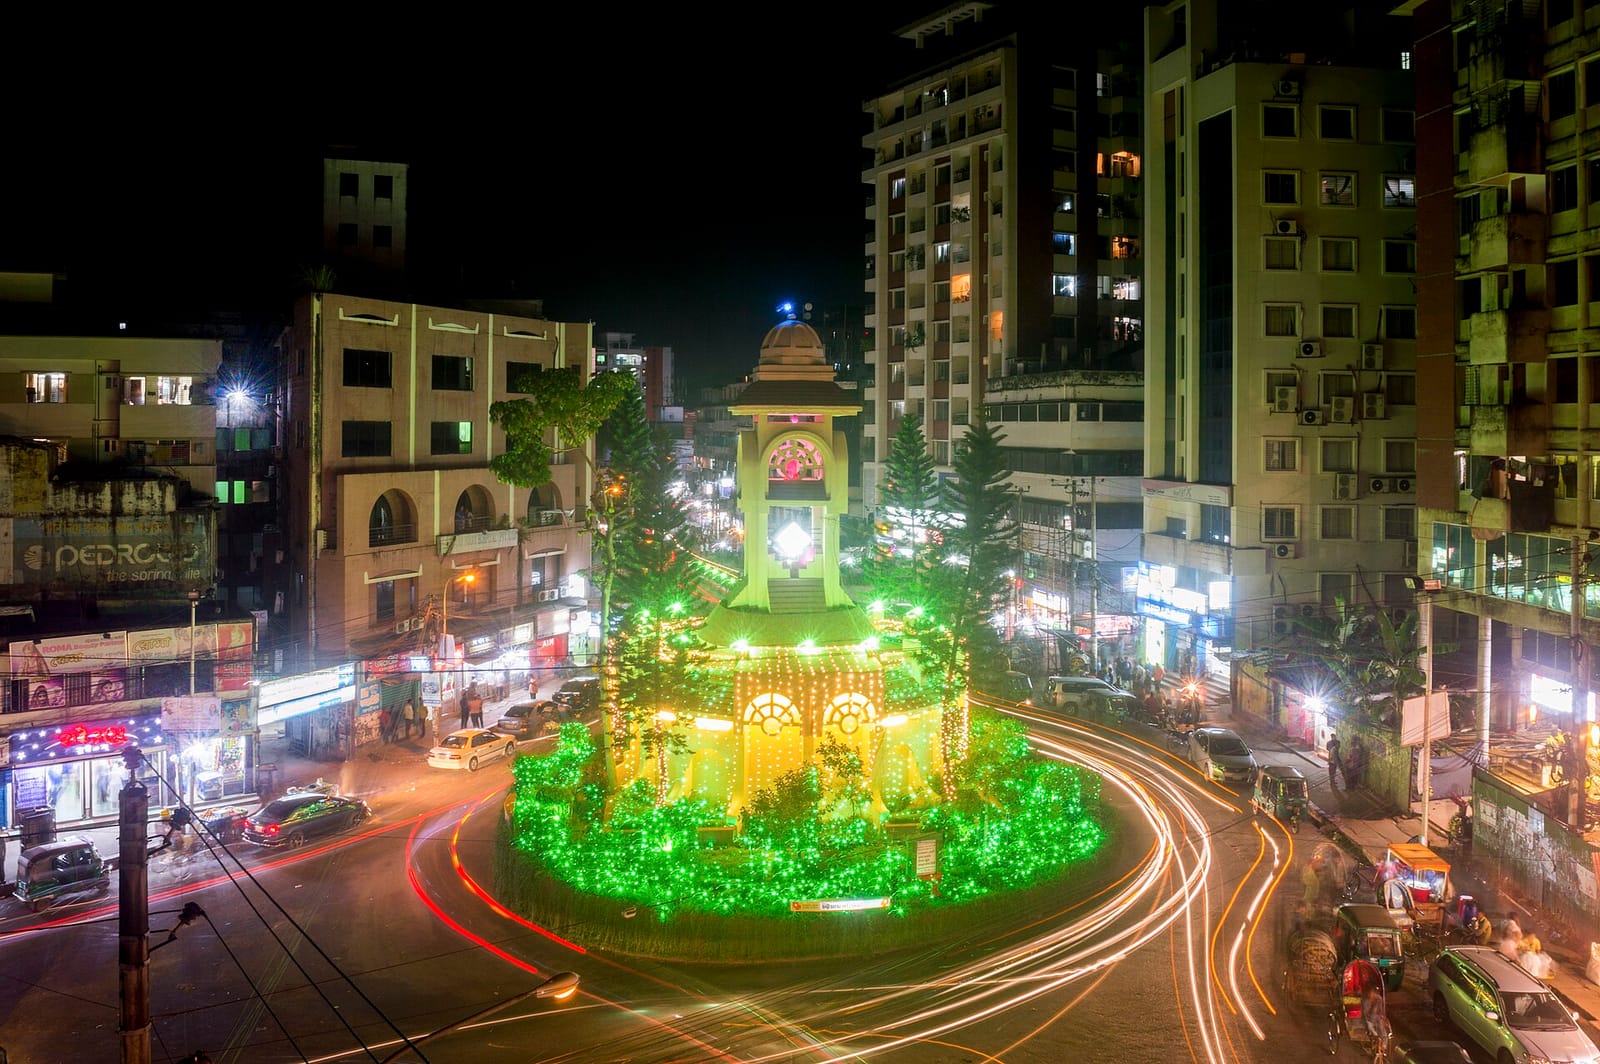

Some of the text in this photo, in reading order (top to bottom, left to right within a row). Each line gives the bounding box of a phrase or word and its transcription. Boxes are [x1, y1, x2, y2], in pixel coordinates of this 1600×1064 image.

[55, 543, 199, 572] PEDRO
[42, 643, 72, 654] ROMA
[131, 636, 172, 653] রোমা
